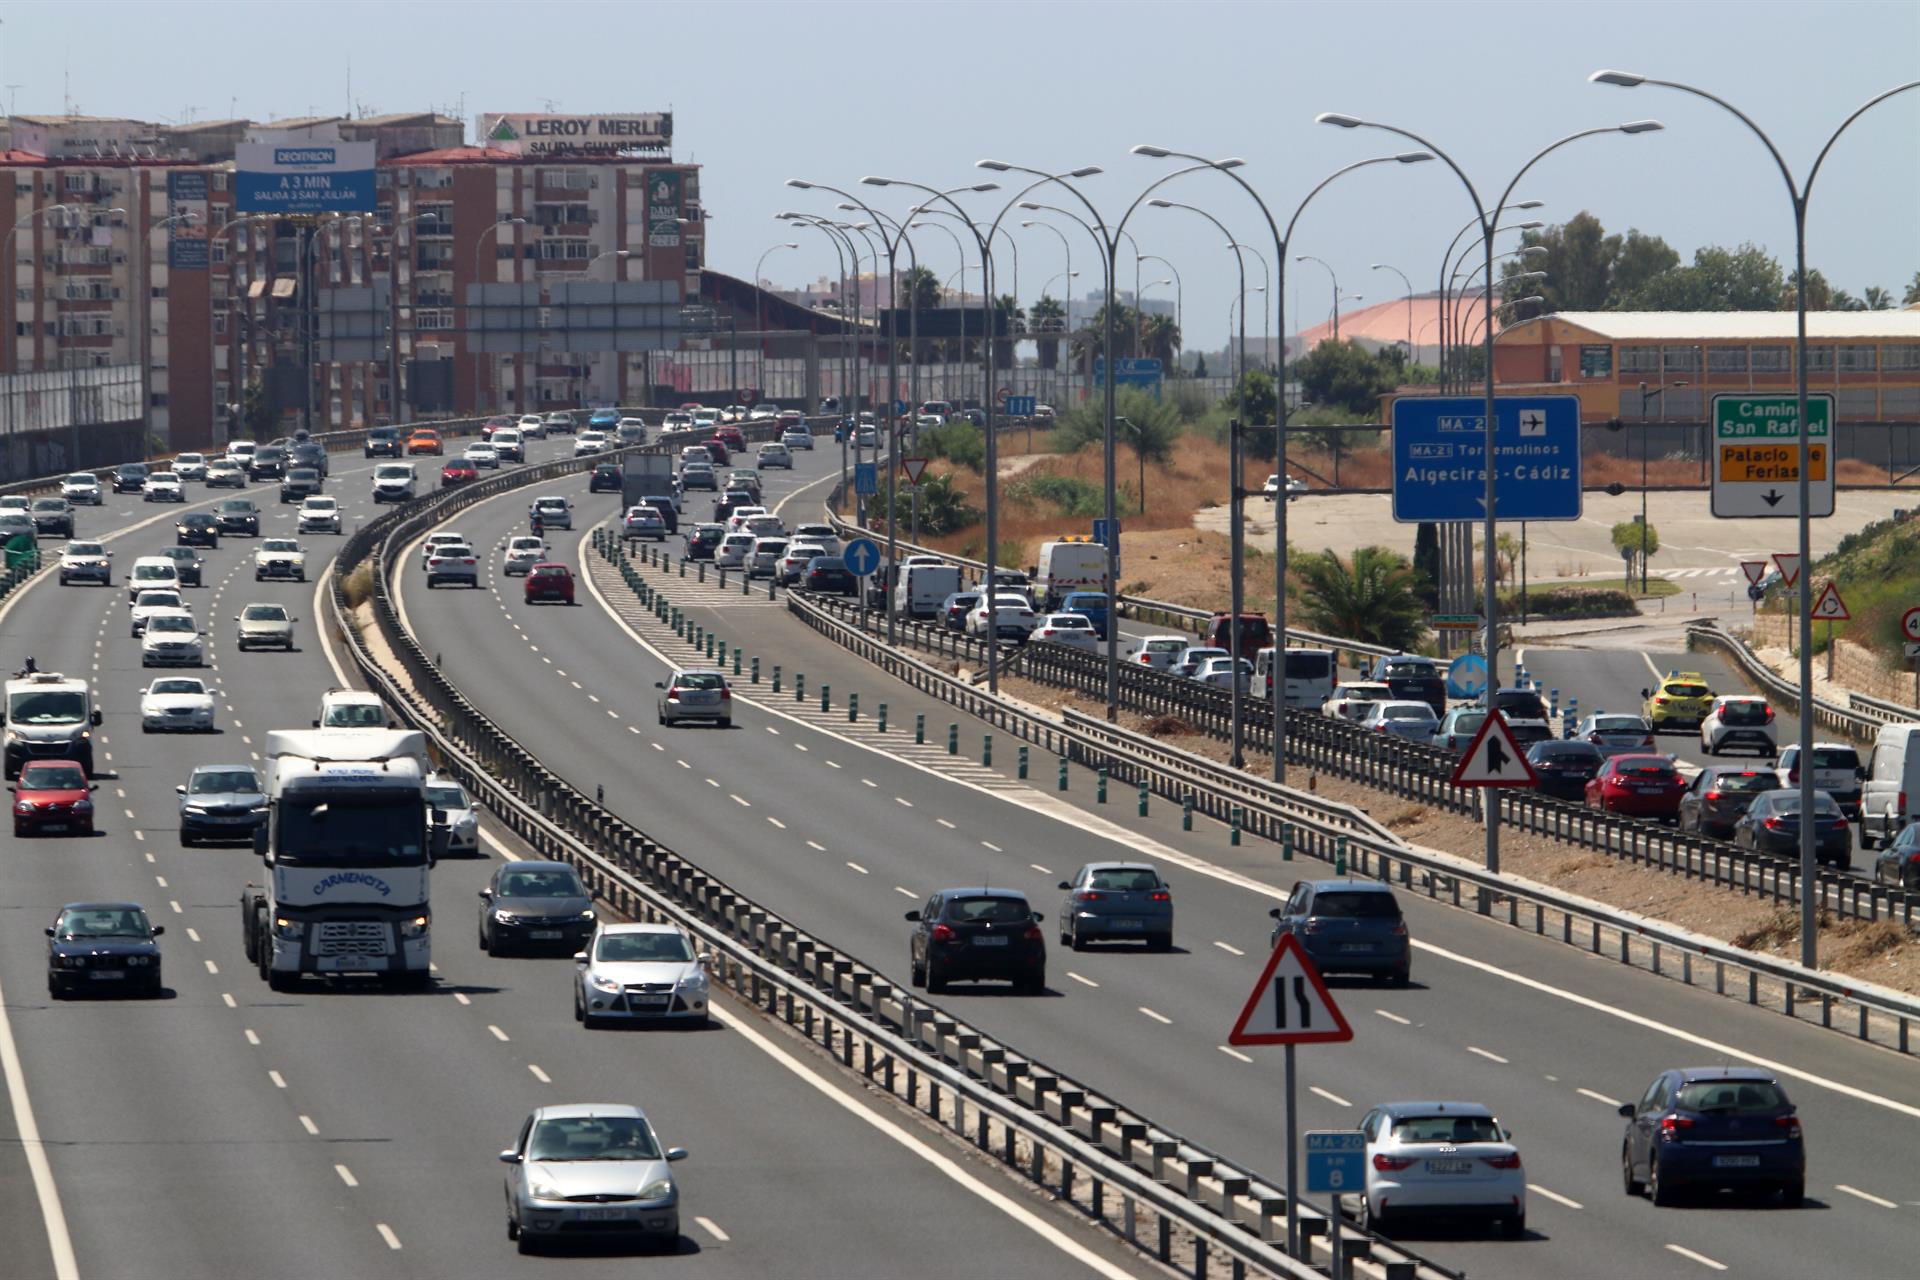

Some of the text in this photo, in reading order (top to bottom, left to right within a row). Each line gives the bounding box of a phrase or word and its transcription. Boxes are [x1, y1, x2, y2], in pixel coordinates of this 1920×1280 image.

[525, 119, 672, 138] LEROY MERLI
[531, 141, 574, 153] SALIDA
[278, 151, 333, 162] DECATHLON
[280, 176, 330, 189] A 3 MIN
[254, 191, 288, 201] SALIDA
[292, 191, 298, 200] 3
[300, 191, 319, 200] SAN
[1441, 418, 1494, 430] MA-2
[1722, 420, 1824, 434] San Rafel
[1459, 445, 1559, 456] Toremolinos
[1725, 448, 1788, 462] Palacio
[1514, 465, 1571, 480] Cádiz
[1745, 465, 1800, 478] Ferias
[313, 872, 391, 896] CARMENCITA
[1311, 1136, 1362, 1149] MA-20
[1329, 1170, 1344, 1188] 8
